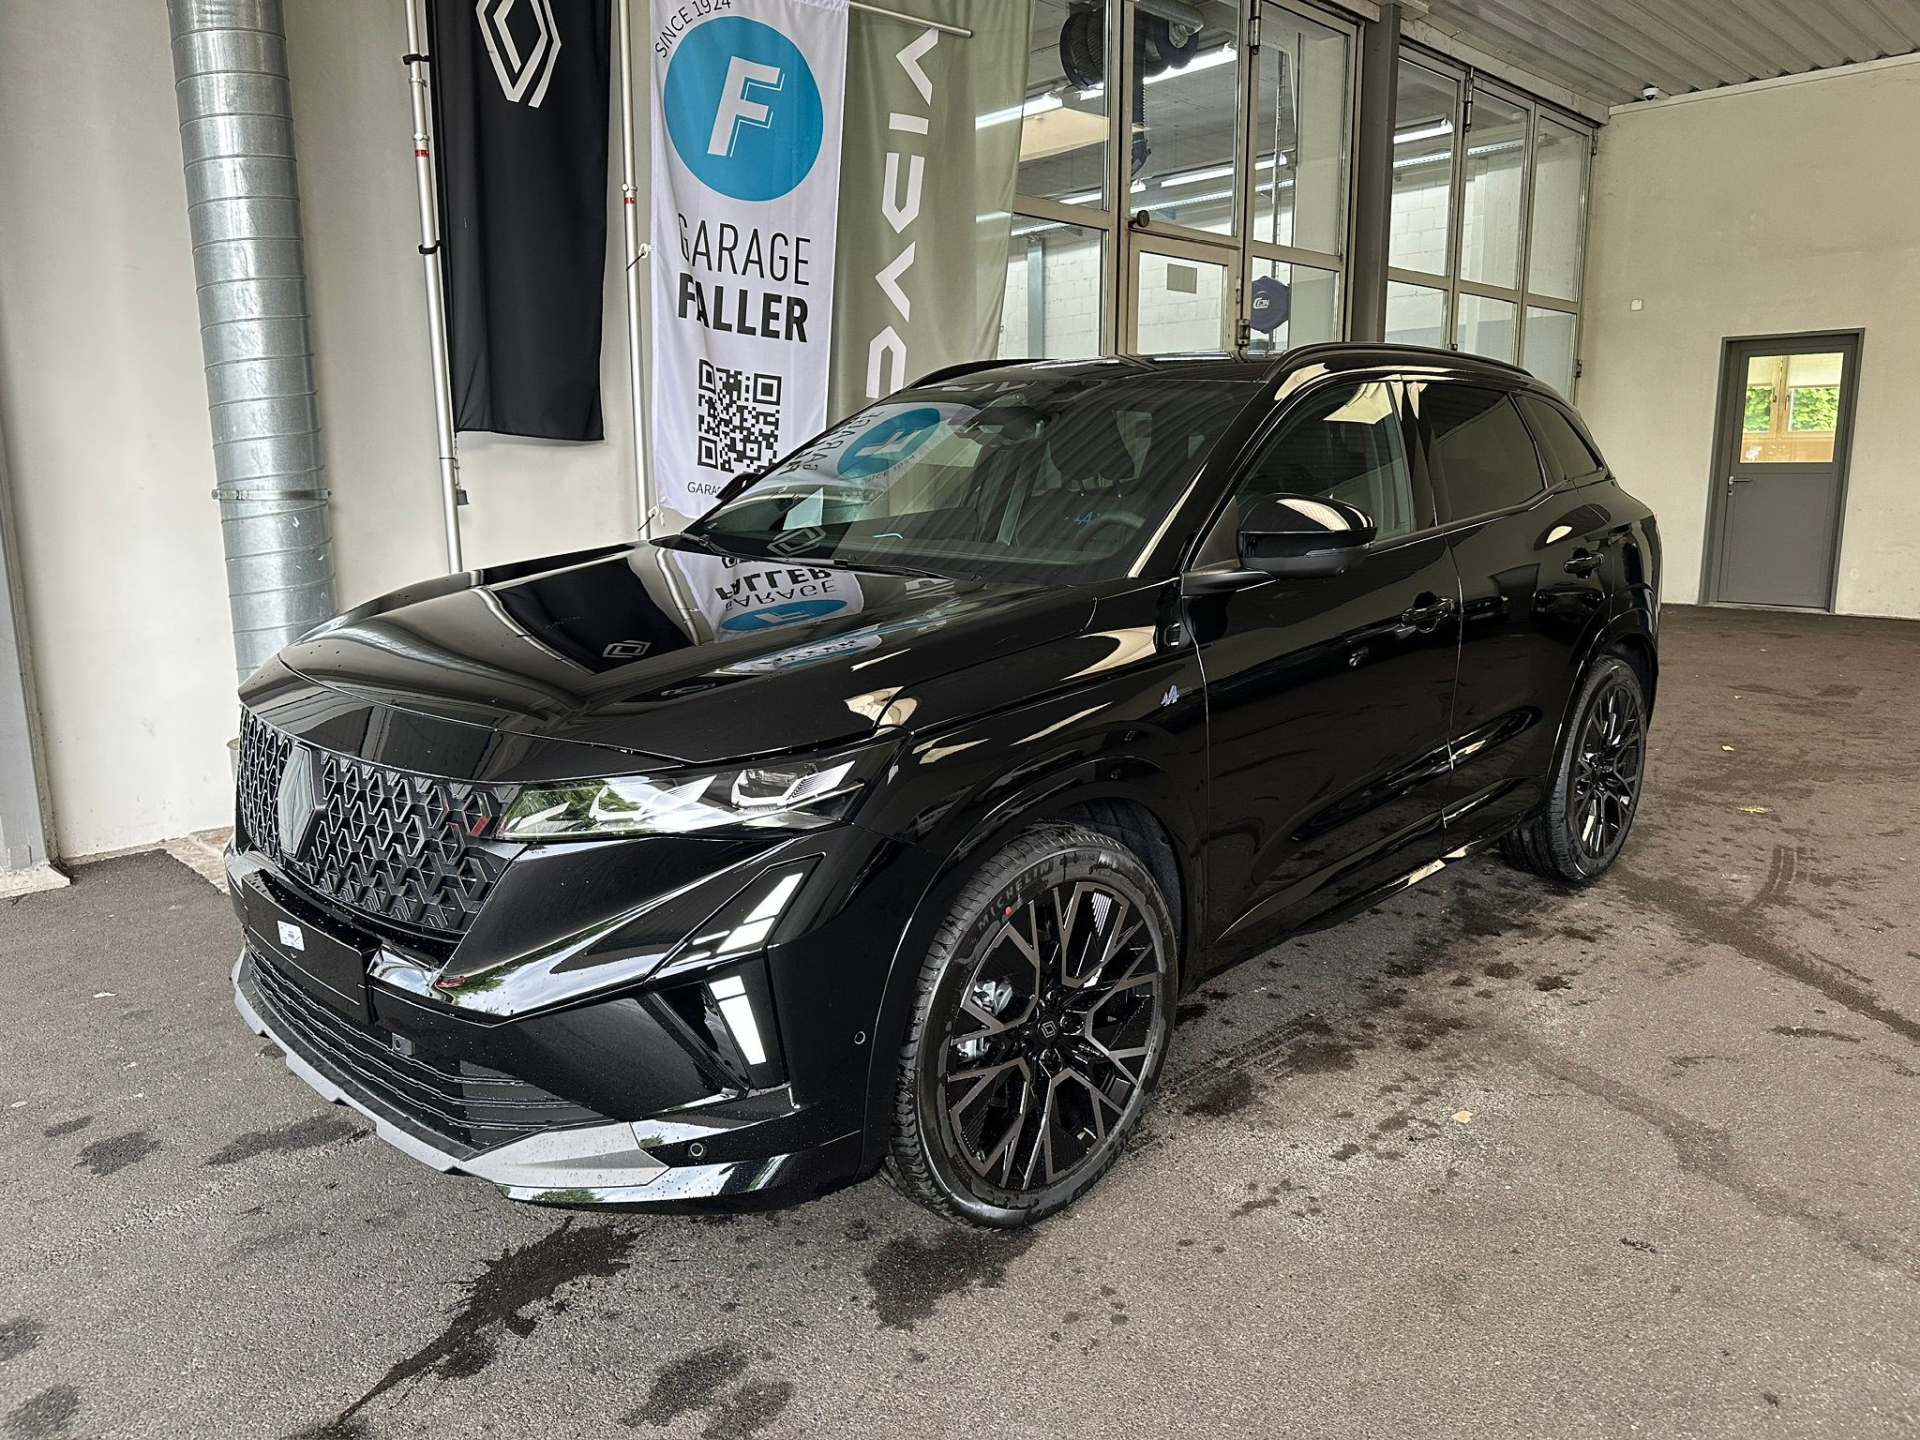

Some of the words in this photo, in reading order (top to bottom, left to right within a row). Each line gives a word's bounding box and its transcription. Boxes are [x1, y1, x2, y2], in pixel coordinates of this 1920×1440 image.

[655, 6, 693, 58] SINCE
[707, 55, 785, 158] F
[678, 212, 811, 286] GARAGE
[678, 272, 809, 343] FALLER
[978, 861, 1050, 931] MICHELIN
